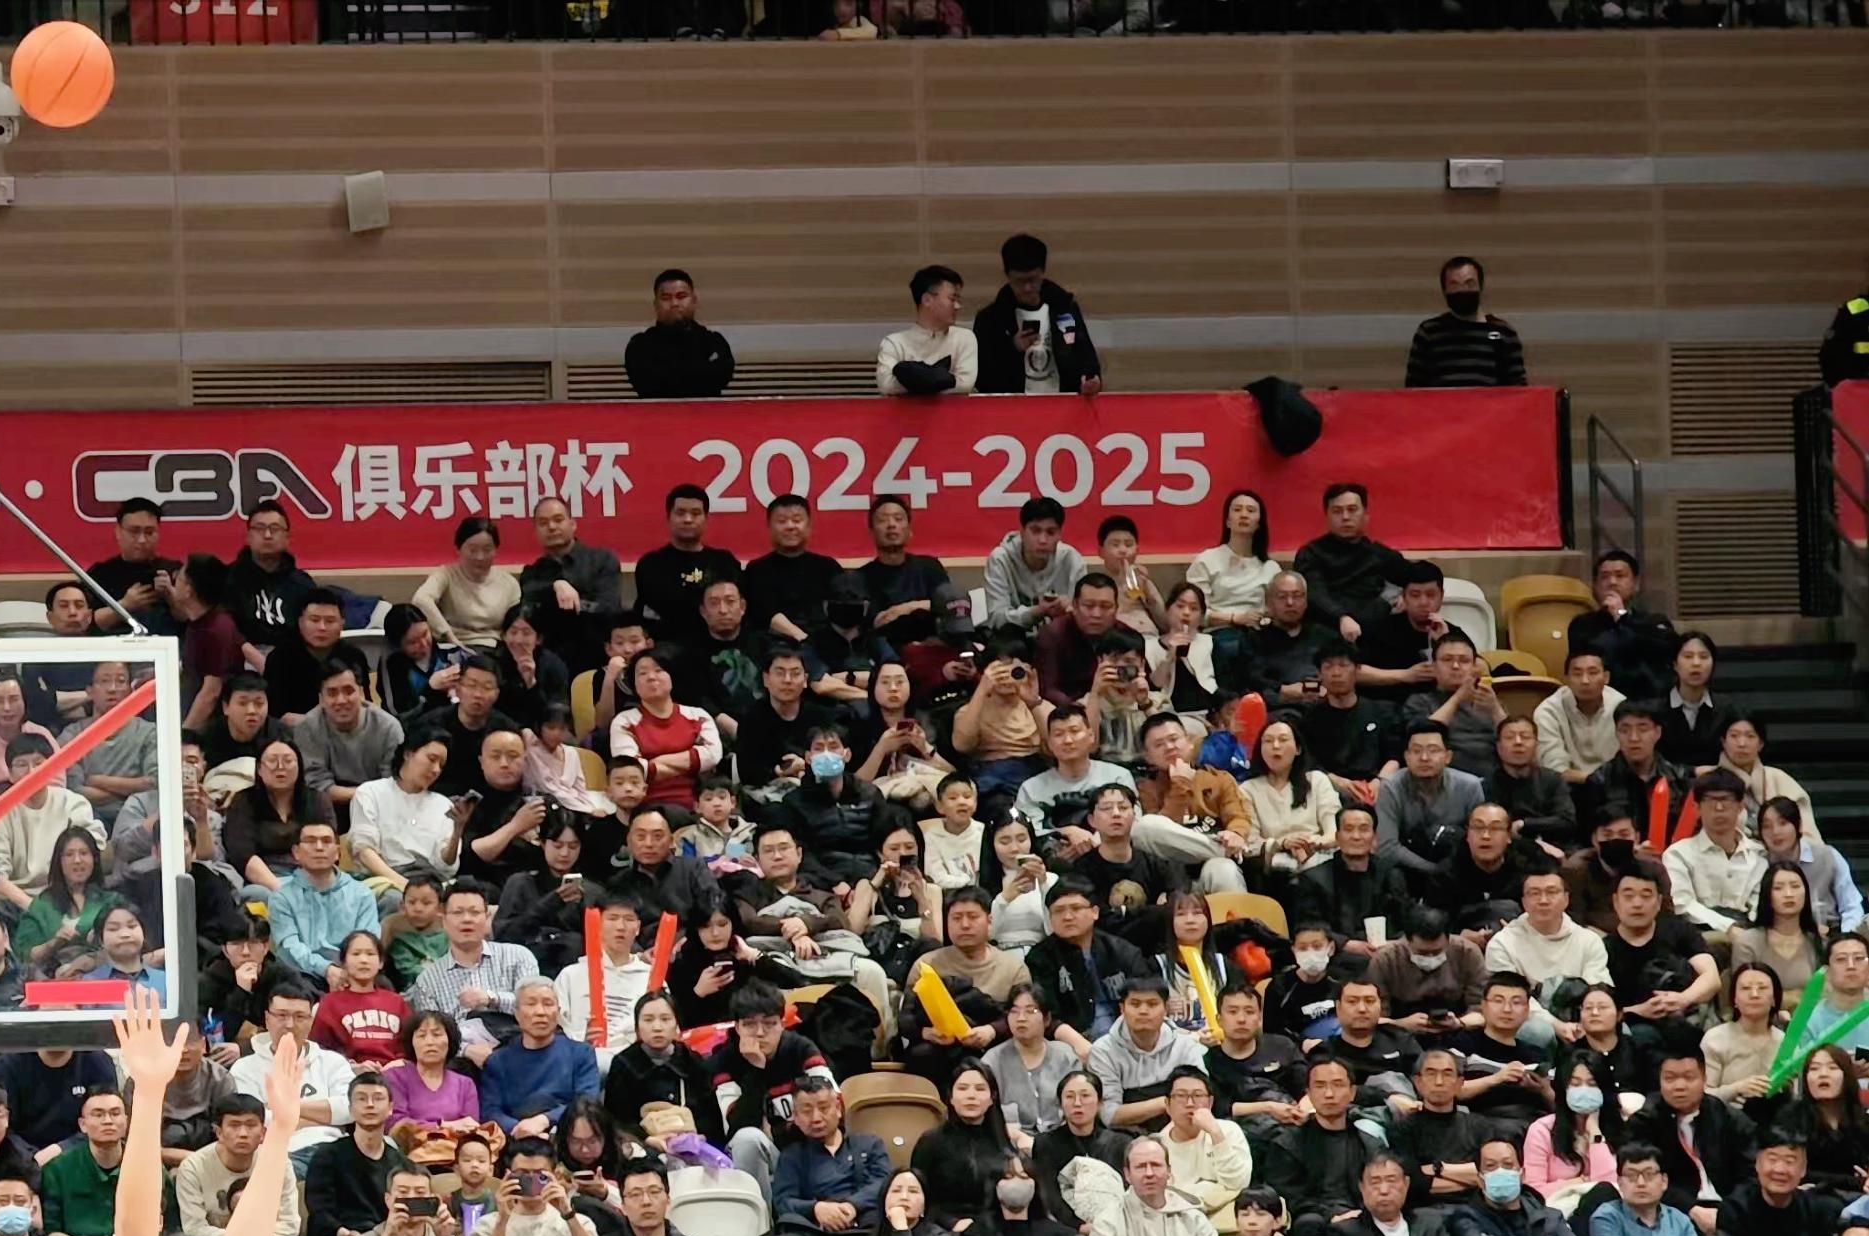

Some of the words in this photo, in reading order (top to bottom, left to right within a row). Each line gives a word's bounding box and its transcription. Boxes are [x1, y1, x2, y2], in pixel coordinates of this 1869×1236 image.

[72, 448, 333, 522] CBA
[332, 439, 634, 522] 俱乐部杯
[687, 431, 1212, 513] 2024-2025
